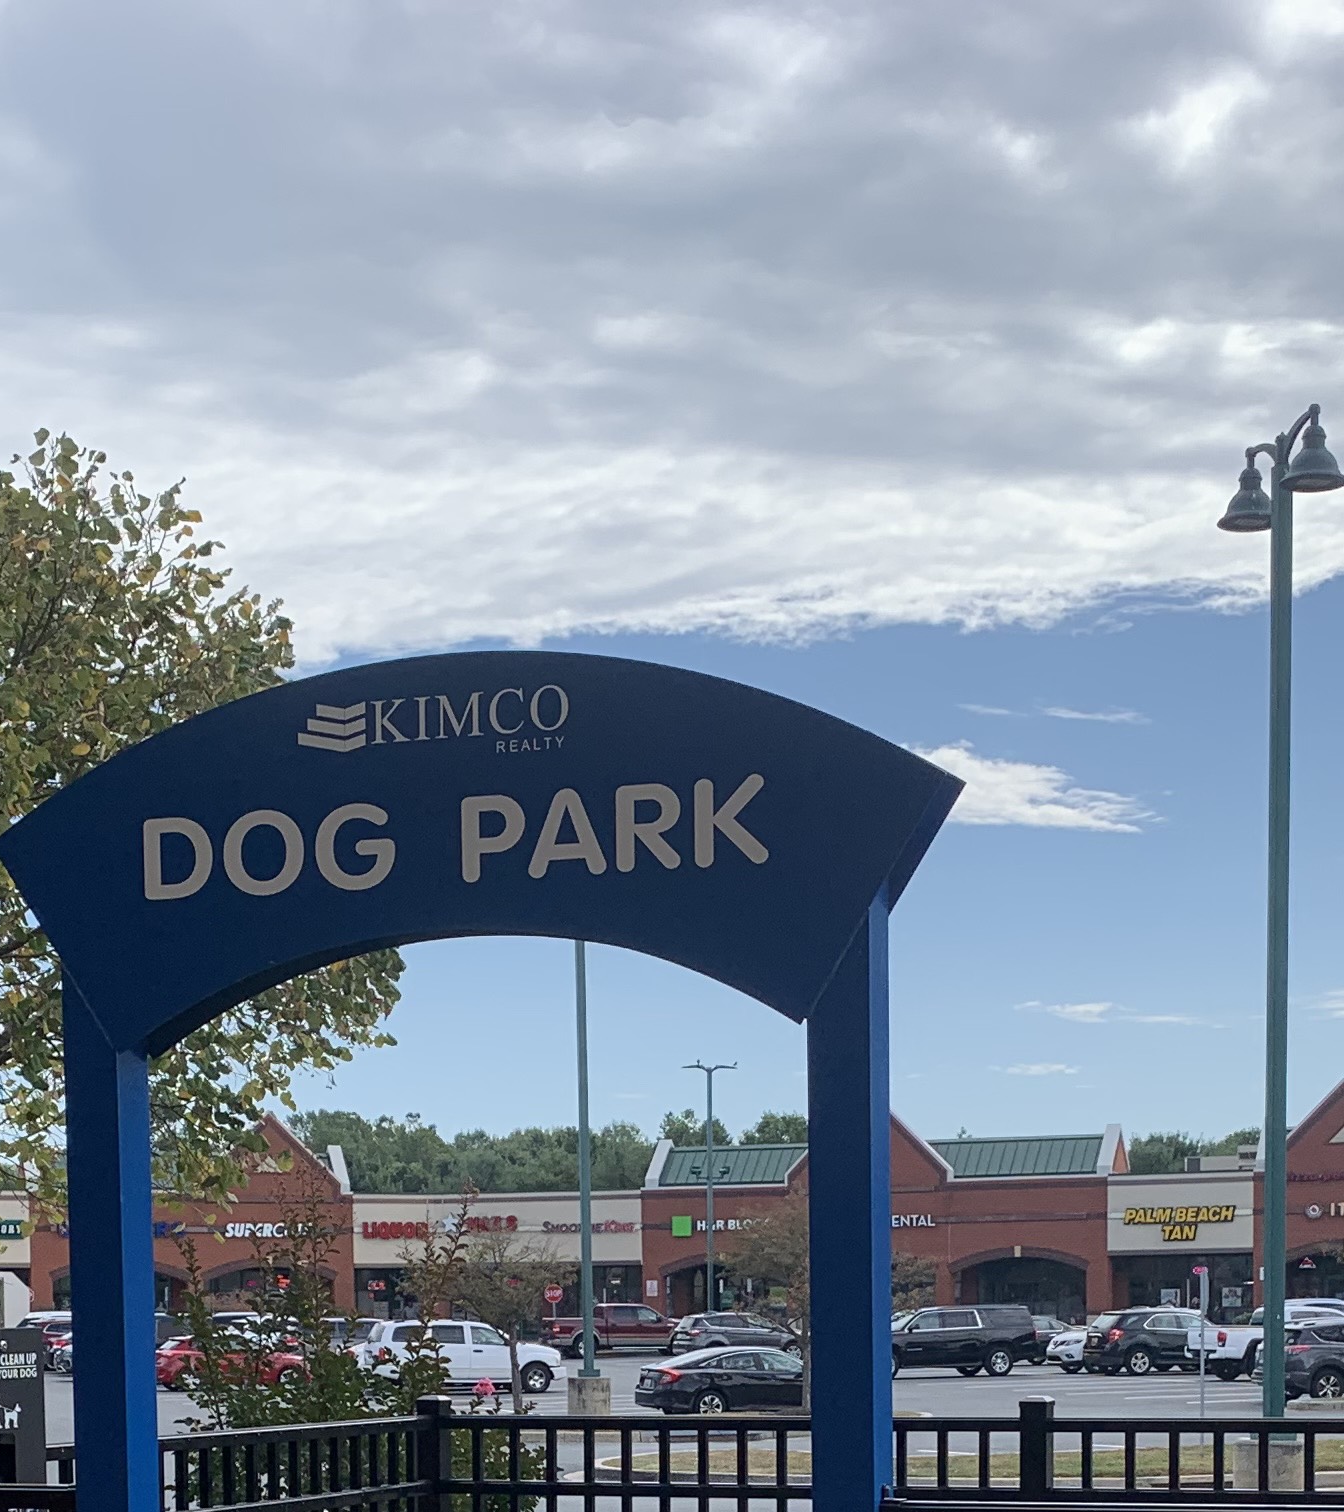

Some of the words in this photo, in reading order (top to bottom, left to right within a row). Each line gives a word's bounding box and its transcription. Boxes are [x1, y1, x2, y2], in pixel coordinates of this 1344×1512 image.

[370, 684, 569, 745] KIMCO
[496, 736, 565, 754] REALTY
[143, 802, 397, 901] DOG
[460, 773, 770, 884] PARK
[891, 1214, 936, 1228] ENTAL
[1124, 1207, 1174, 1225] PALM
[1174, 1205, 1236, 1224] BEACH
[225, 1222, 313, 1238] SUPERCTS
[727, 1217, 770, 1231] BLOC
[1162, 1224, 1198, 1241] TAN
[545, 1289, 563, 1298] STOP
[0, 1353, 25, 1366] CLEAN
[26, 1353, 37, 1364] UP
[19, 1368, 37, 1378] DOG
